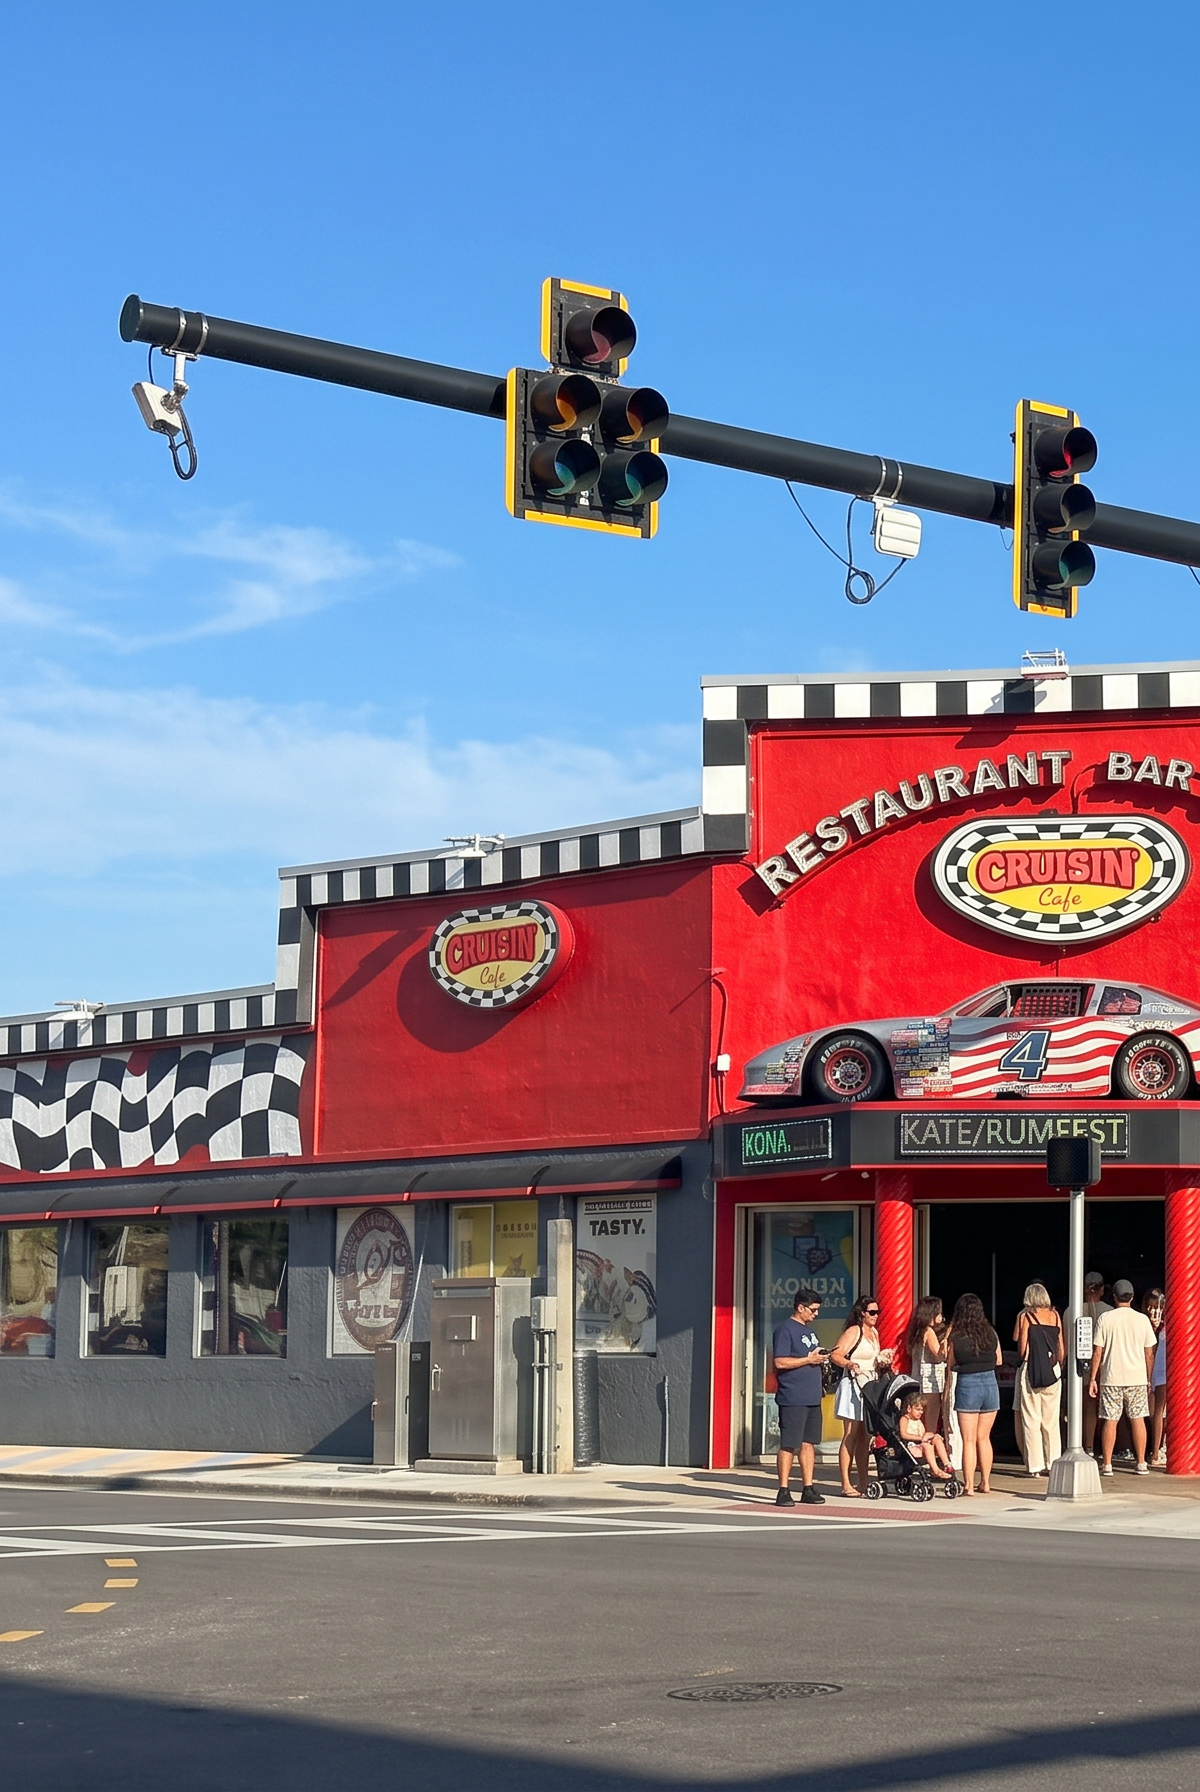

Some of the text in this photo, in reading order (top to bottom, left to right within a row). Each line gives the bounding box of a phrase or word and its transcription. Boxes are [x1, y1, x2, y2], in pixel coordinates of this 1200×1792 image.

[755, 750, 1073, 896] RESTAURANT
[1107, 751, 1195, 792] BAR
[1038, 886, 1082, 912] Cafe
[480, 965, 506, 988] Cafe
[998, 1030, 1051, 1082] 4
[745, 1129, 791, 1157] KONA.
[589, 1218, 646, 1236] TASTY.
